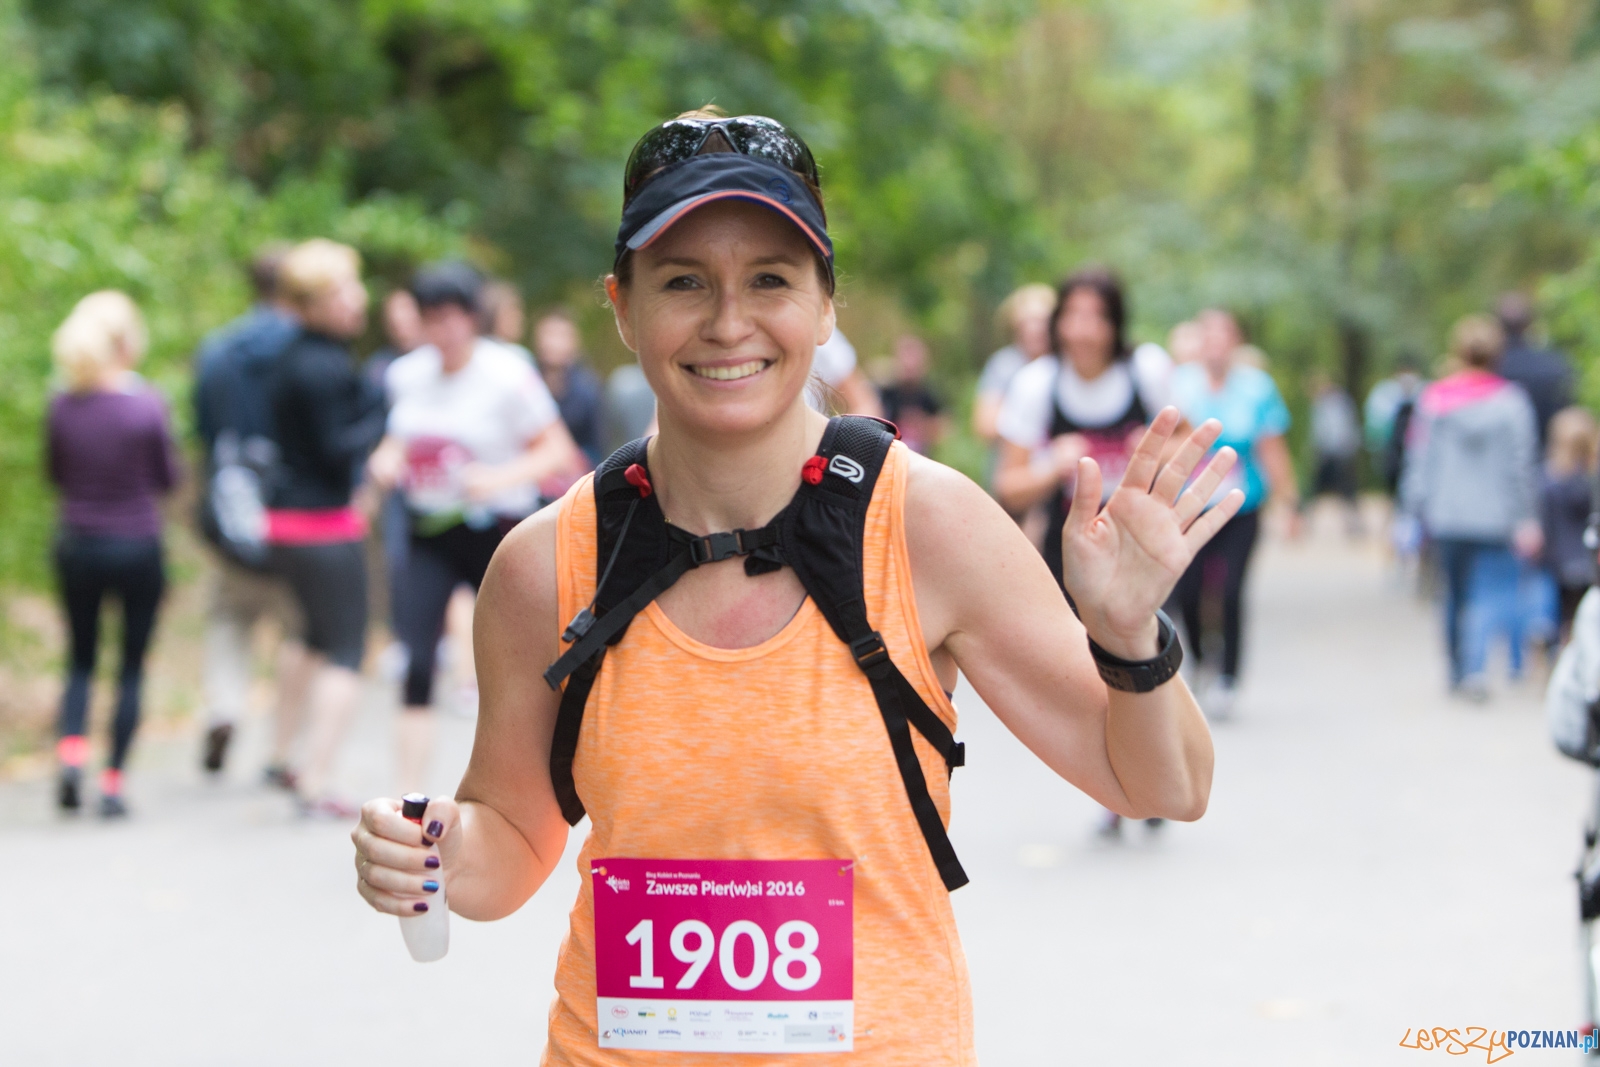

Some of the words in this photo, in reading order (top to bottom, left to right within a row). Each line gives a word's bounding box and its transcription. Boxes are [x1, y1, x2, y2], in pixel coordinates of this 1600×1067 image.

[646, 880, 698, 895] Zawsze
[701, 880, 763, 898] Pier(w)si
[766, 881, 805, 896] 2016
[625, 919, 822, 991] 1908
